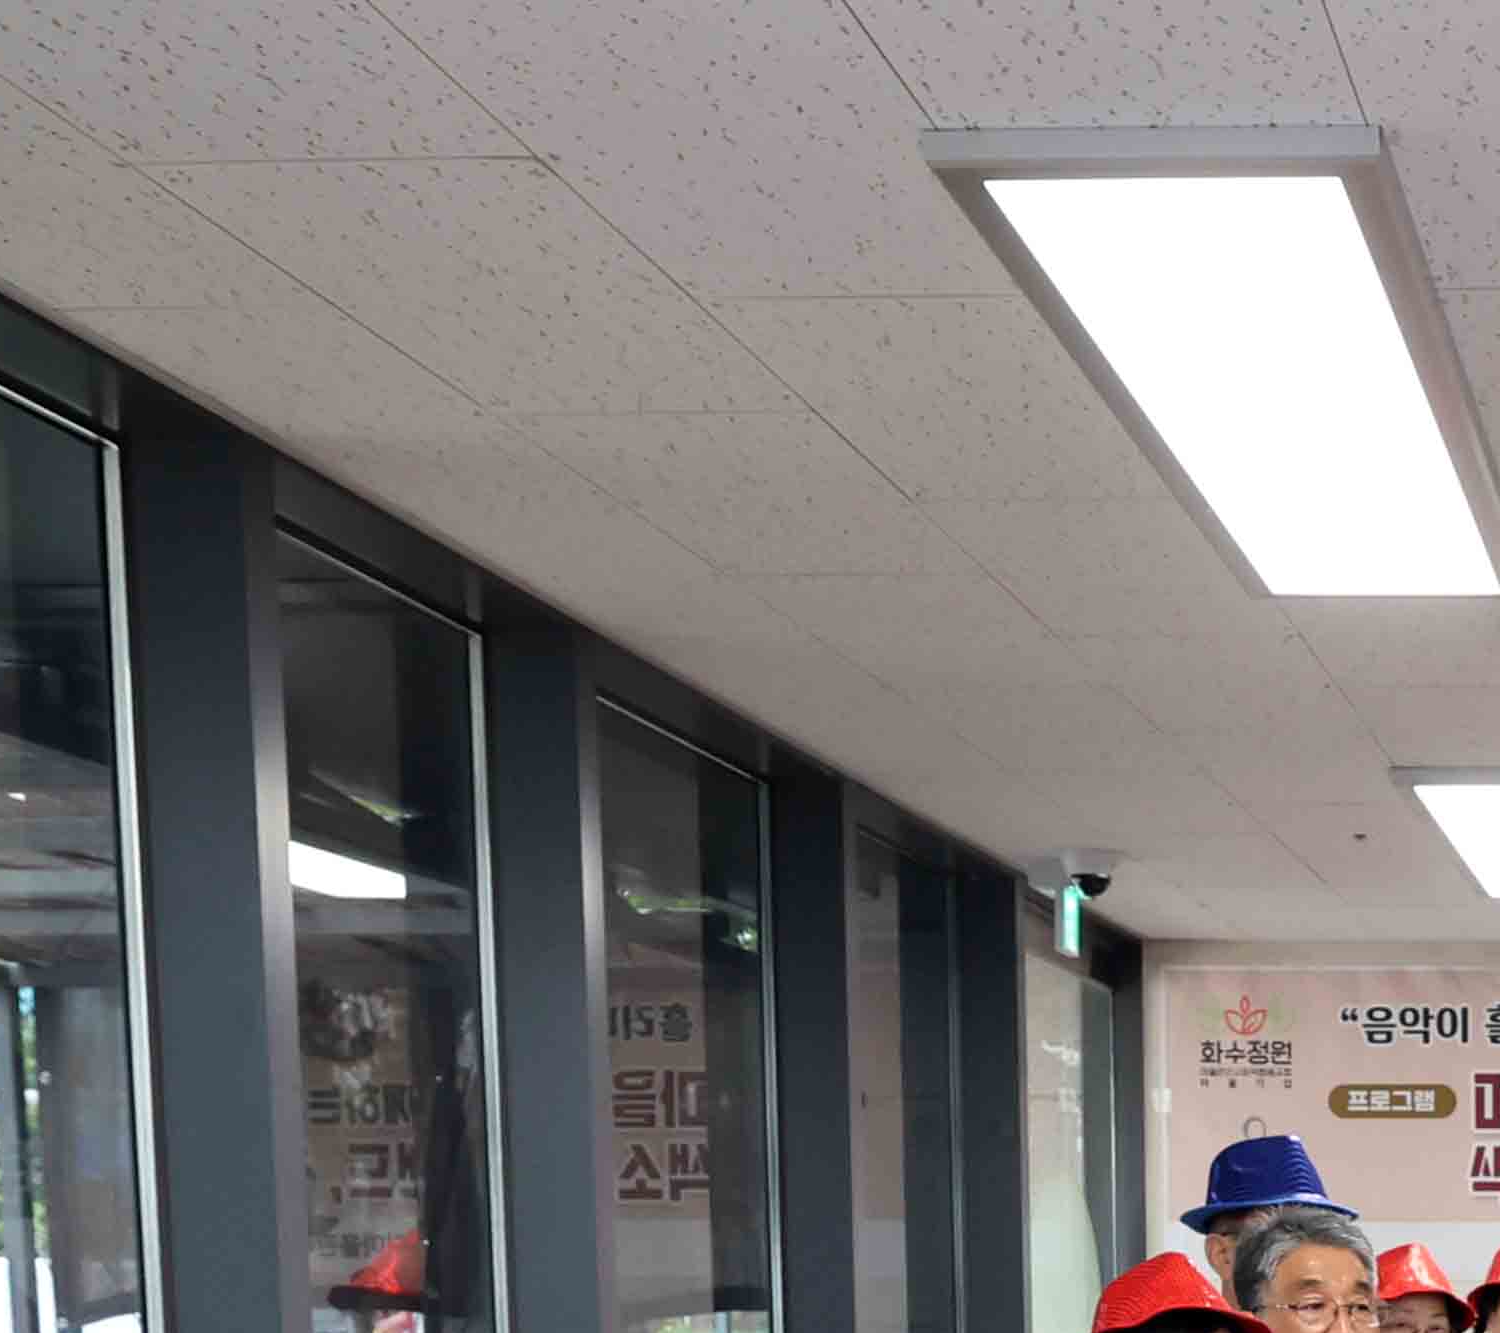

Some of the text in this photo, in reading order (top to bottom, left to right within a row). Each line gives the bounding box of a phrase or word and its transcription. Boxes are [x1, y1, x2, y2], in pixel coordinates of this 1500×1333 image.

[1340, 1005, 1469, 1045] “음악이
[1199, 1040, 1293, 1066] 화수정원
[1347, 1089, 1436, 1113] 프로그램
